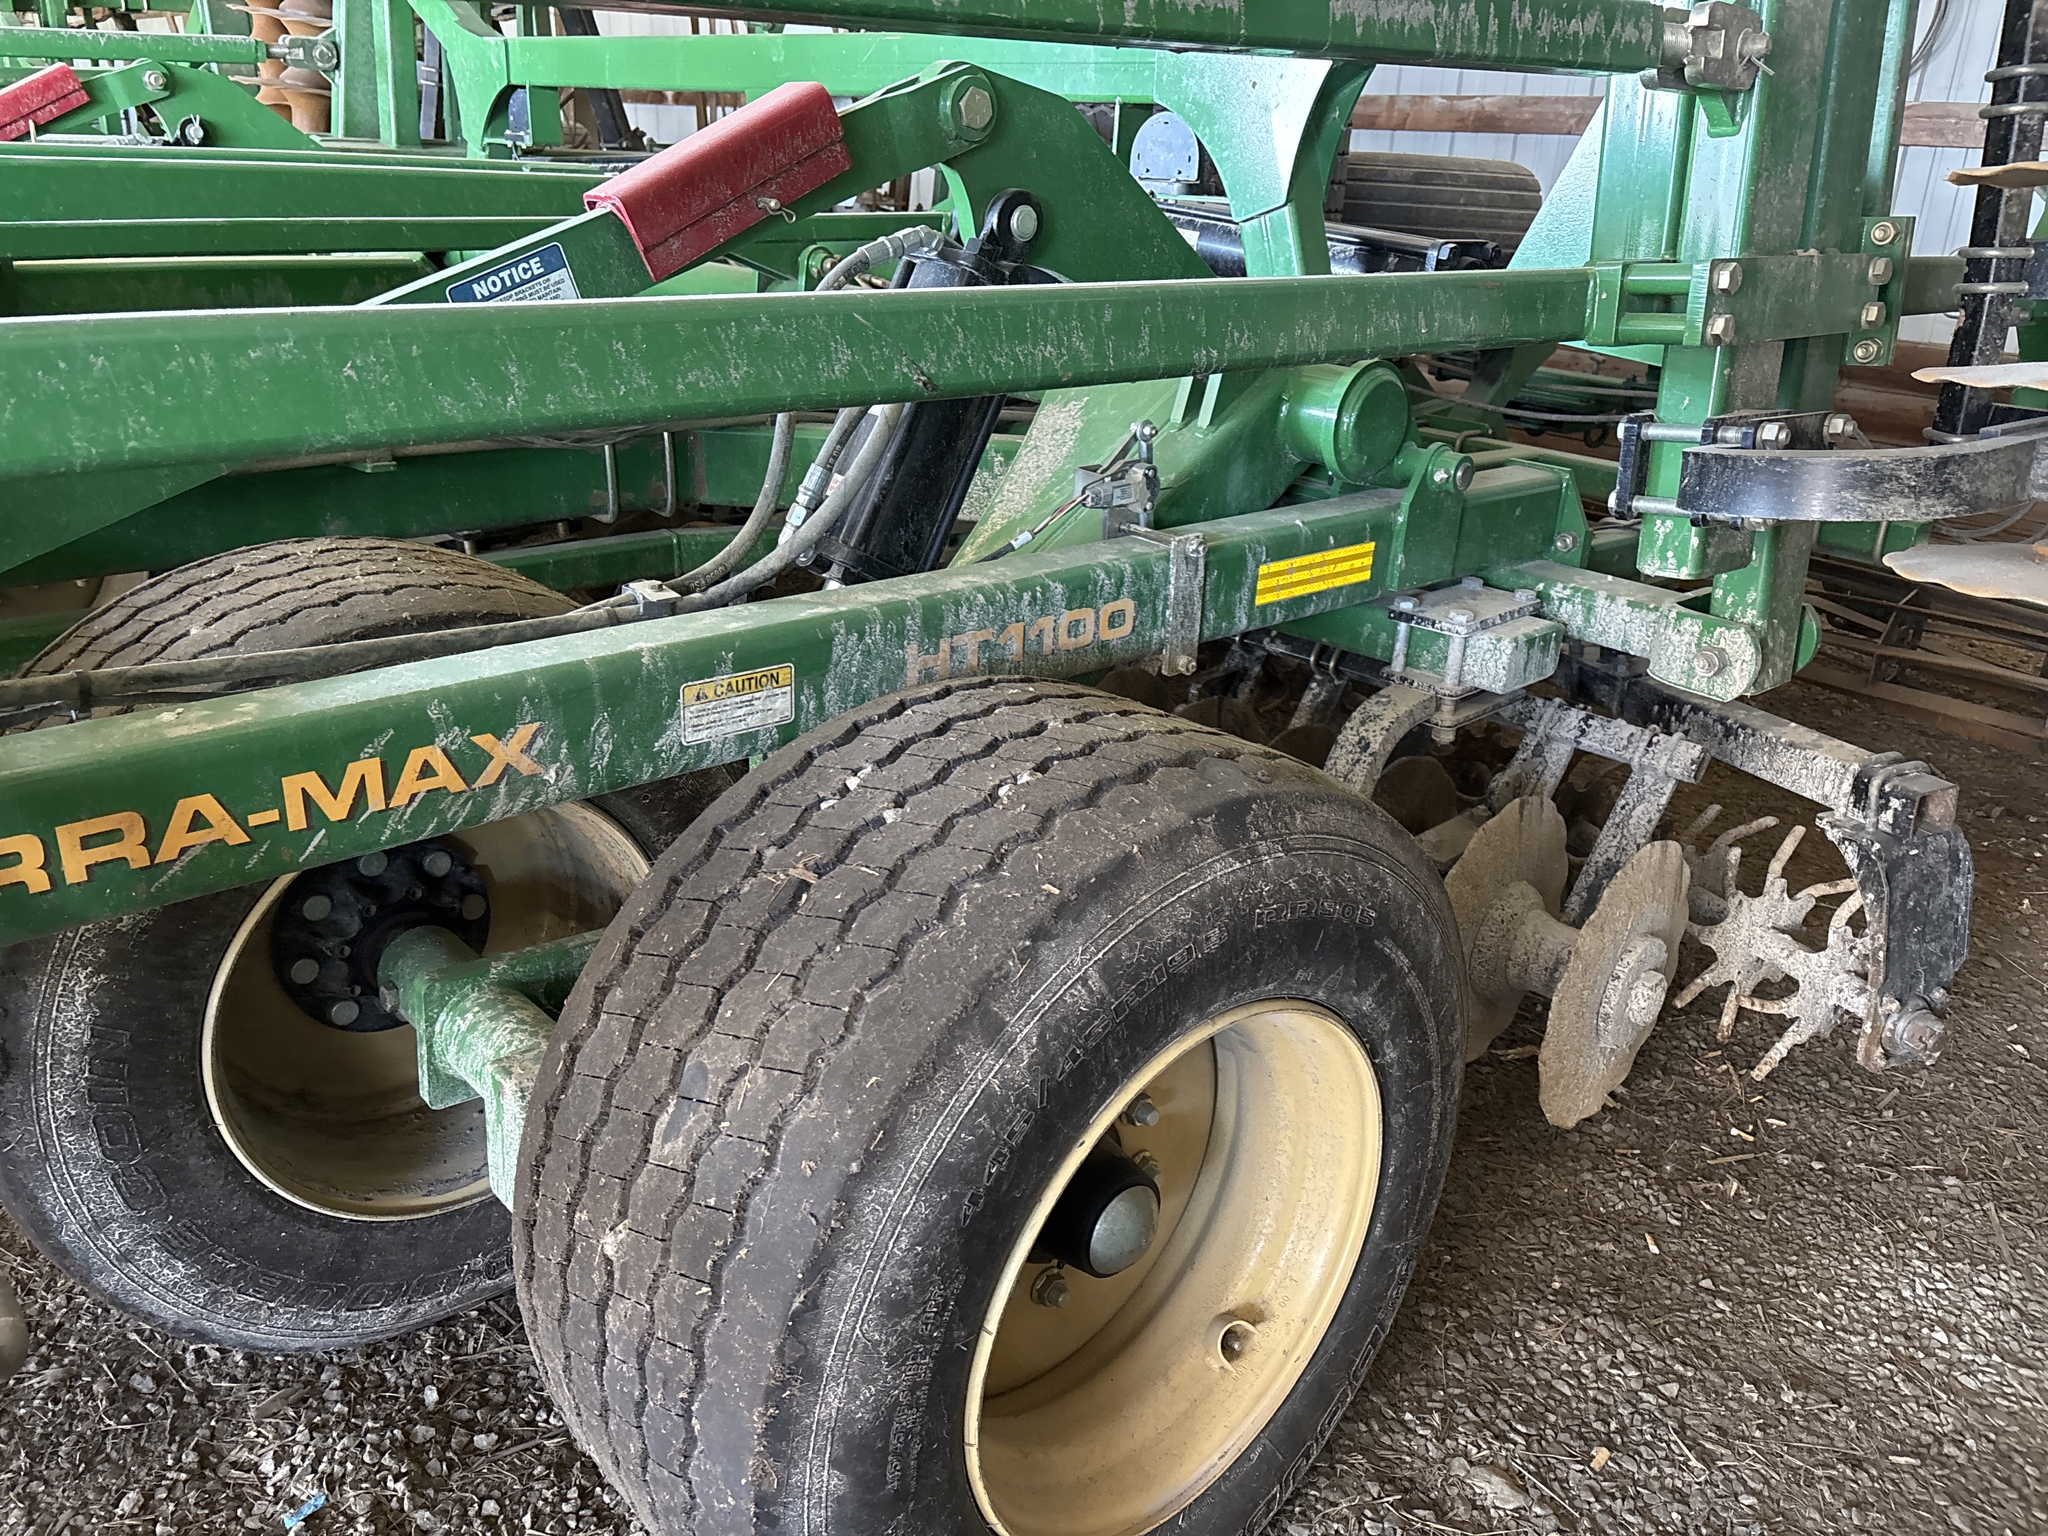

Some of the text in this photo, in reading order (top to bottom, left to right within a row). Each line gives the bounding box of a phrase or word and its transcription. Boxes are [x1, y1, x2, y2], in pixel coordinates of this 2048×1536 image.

[472, 257, 545, 300] NOTICE
[514, 281, 542, 297] BRACKETS
[542, 277, 551, 285] OR
[528, 287, 543, 297] MUST
[543, 284, 550, 292] BE
[551, 277, 565, 288] USED
[906, 597, 1136, 687] HT1100
[714, 671, 779, 697] CAUTION
